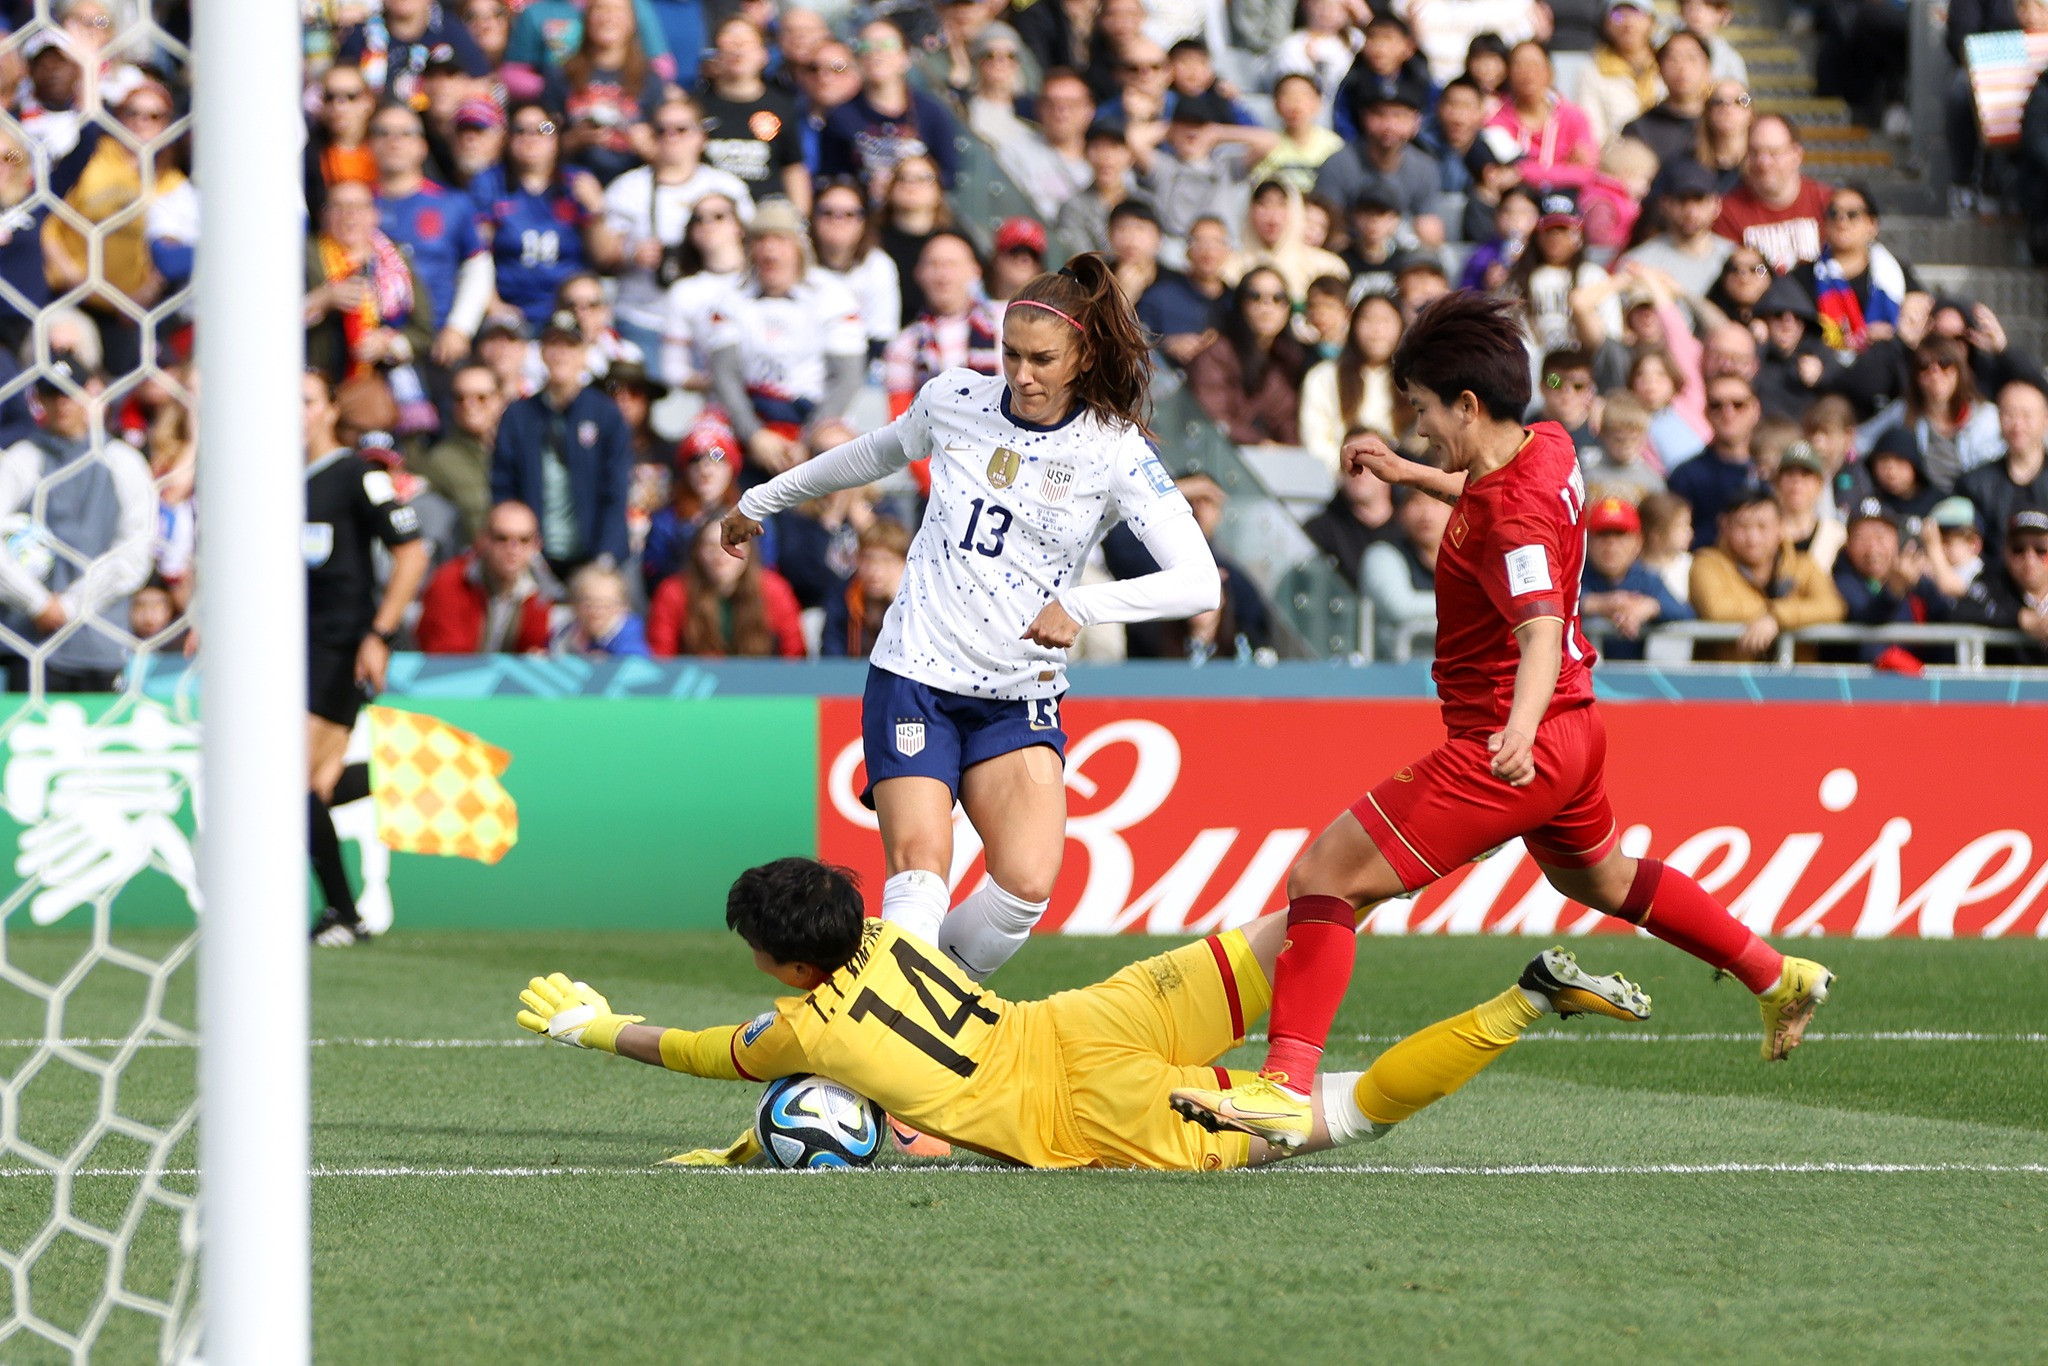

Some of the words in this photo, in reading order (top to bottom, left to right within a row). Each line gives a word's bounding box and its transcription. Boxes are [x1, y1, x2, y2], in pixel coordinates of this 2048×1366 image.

[1047, 468, 1071, 484] USA
[959, 498, 1014, 558] 13
[898, 726, 923, 737] USA
[1027, 697, 1058, 728] 13
[828, 719, 2048, 939] Buweise
[848, 937, 1000, 1078] 14
